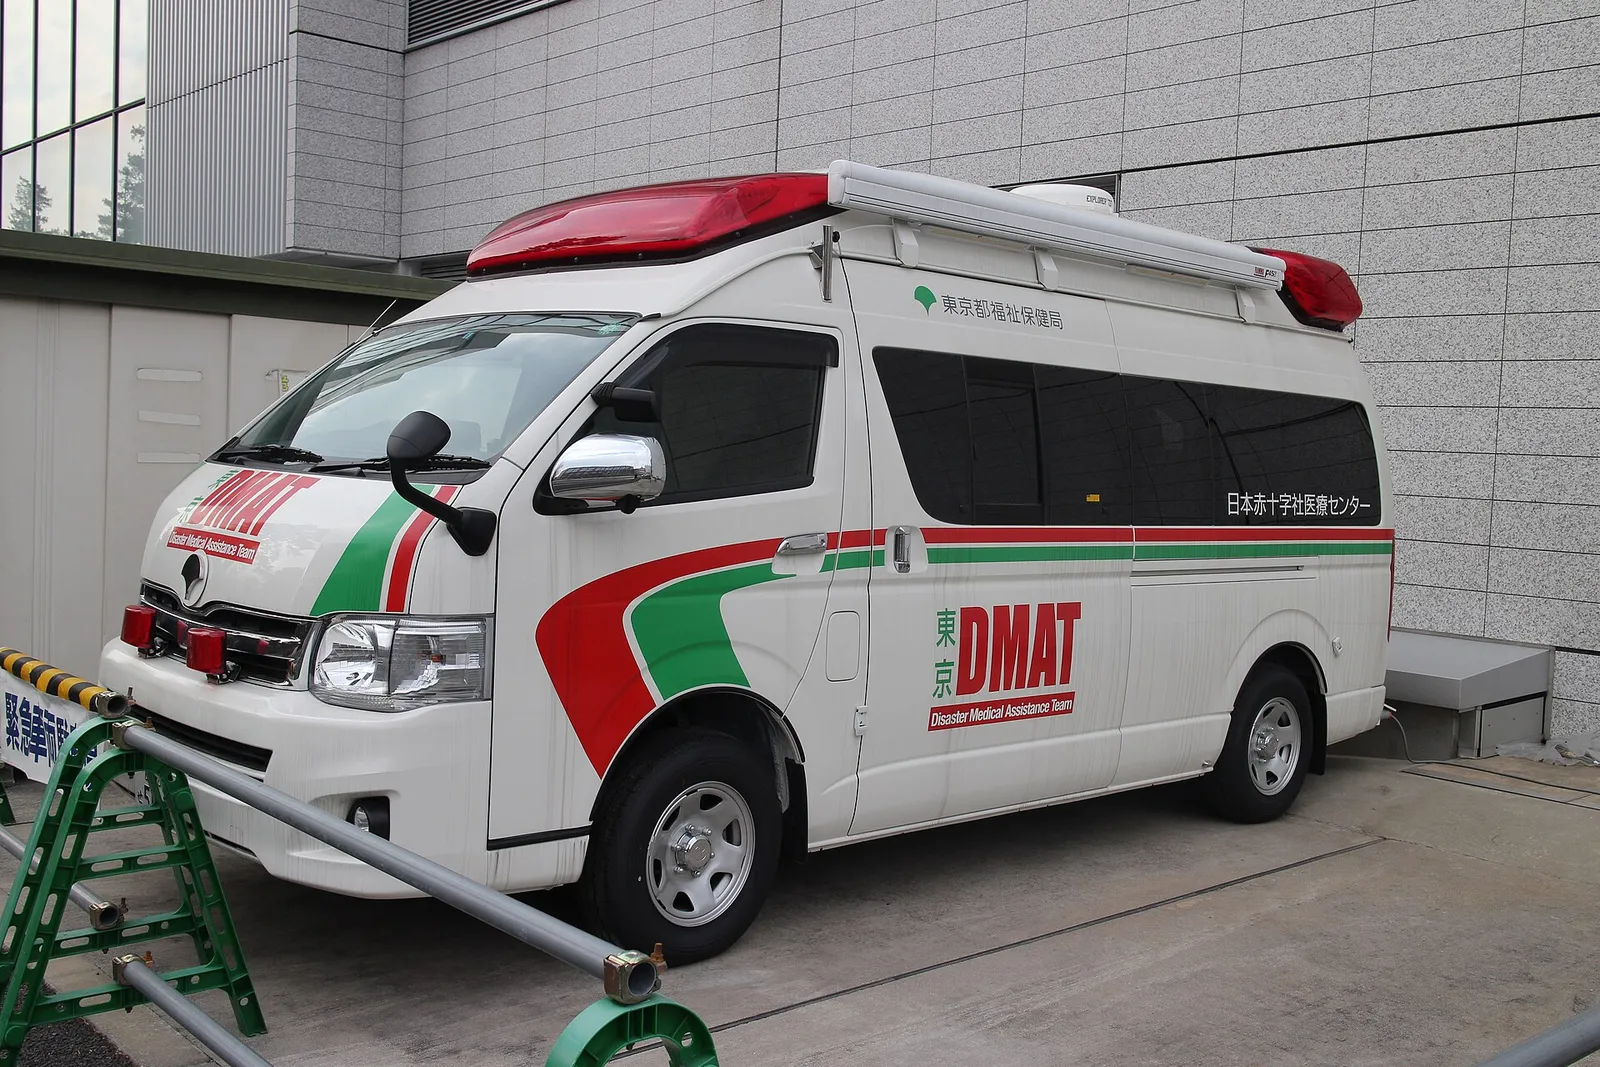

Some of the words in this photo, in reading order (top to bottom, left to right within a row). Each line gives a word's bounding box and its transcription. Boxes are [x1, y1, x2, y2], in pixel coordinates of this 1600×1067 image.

[941, 295, 1064, 330] 東京都福祉保健局
[187, 469, 322, 537] DMAT
[1227, 491, 1371, 516] 日本赤十字社医療センター
[168, 531, 188, 546] Disaster
[186, 533, 208, 549] Medical
[204, 537, 237, 556] Assistance
[236, 543, 256, 560] Team
[932, 608, 957, 699] 東京
[956, 602, 1082, 696] DMAT
[930, 711, 969, 728] Disaster
[969, 705, 1003, 722] Medical
[1004, 701, 1050, 718] Assistance
[1051, 699, 1073, 711] Team
